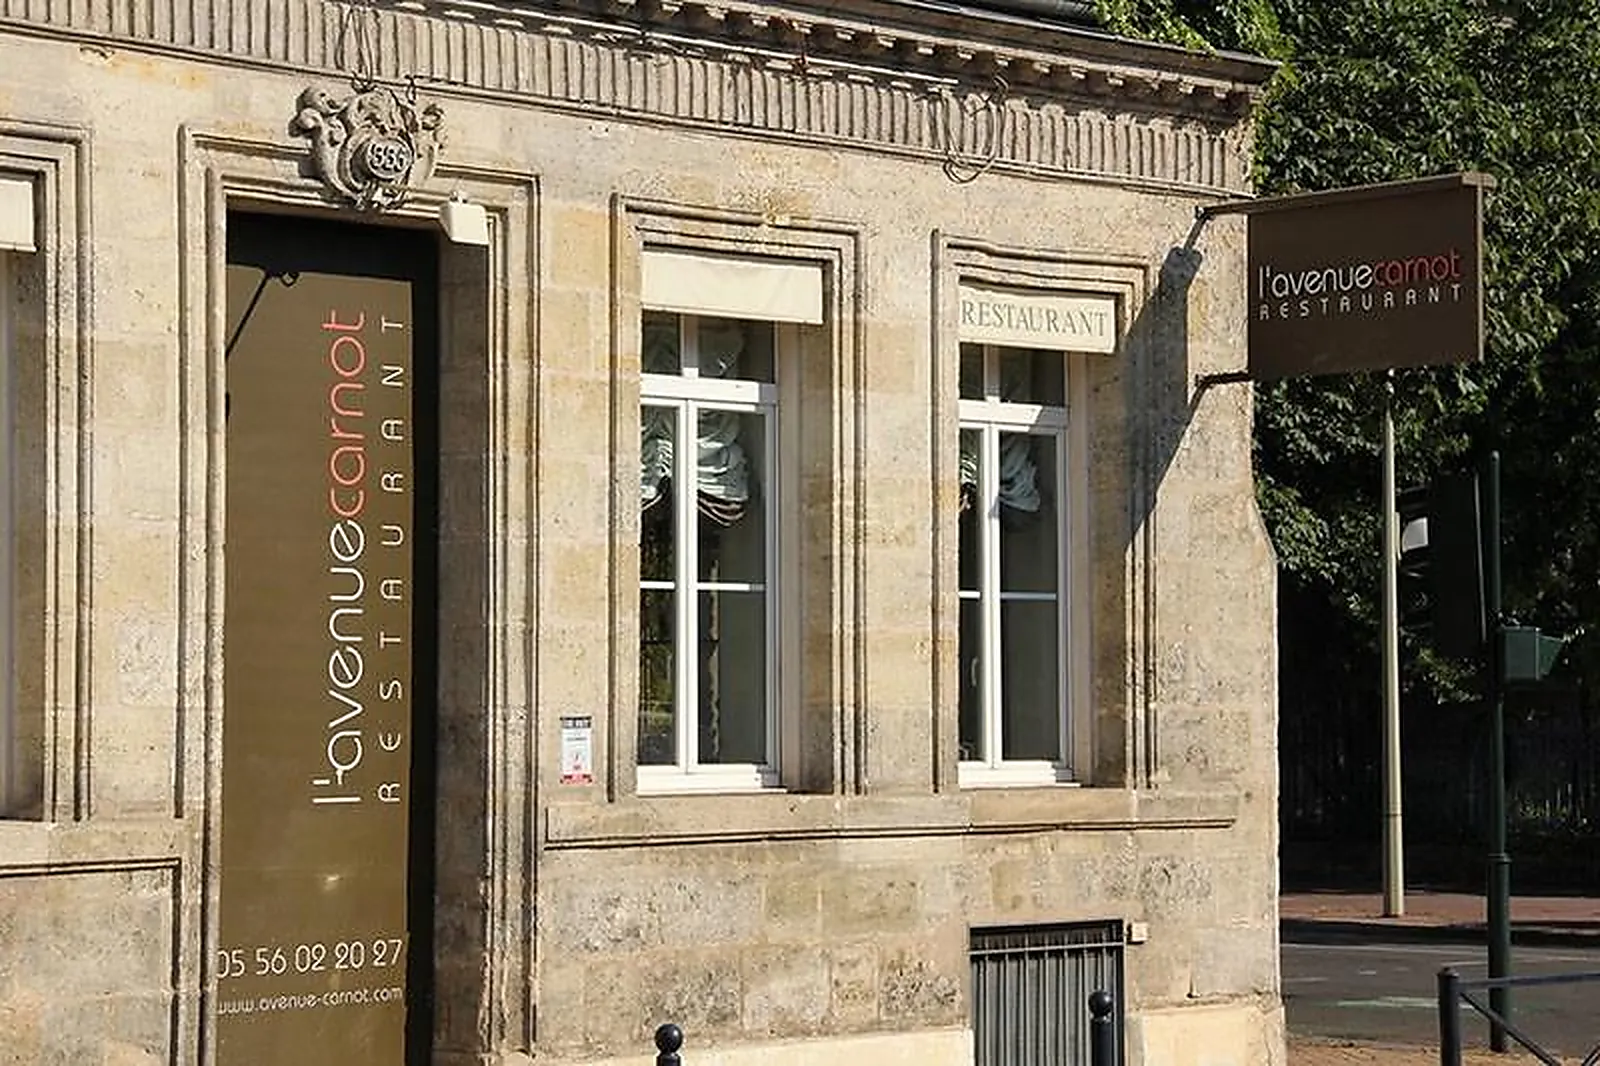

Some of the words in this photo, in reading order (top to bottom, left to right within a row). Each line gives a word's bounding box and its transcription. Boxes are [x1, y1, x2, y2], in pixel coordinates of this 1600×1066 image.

[1258, 251, 1460, 298] l'avenuecarnot
[961, 300, 1107, 336] RESTAURANT
[1259, 284, 1461, 320] RESTAURANT
[312, 310, 366, 803] l'avenuecarnot
[378, 315, 403, 802] RESTAURANT
[216, 950, 246, 978] 05
[255, 948, 287, 976] 56
[295, 944, 327, 972] 02
[335, 941, 365, 969] 20
[373, 939, 403, 967] 27
